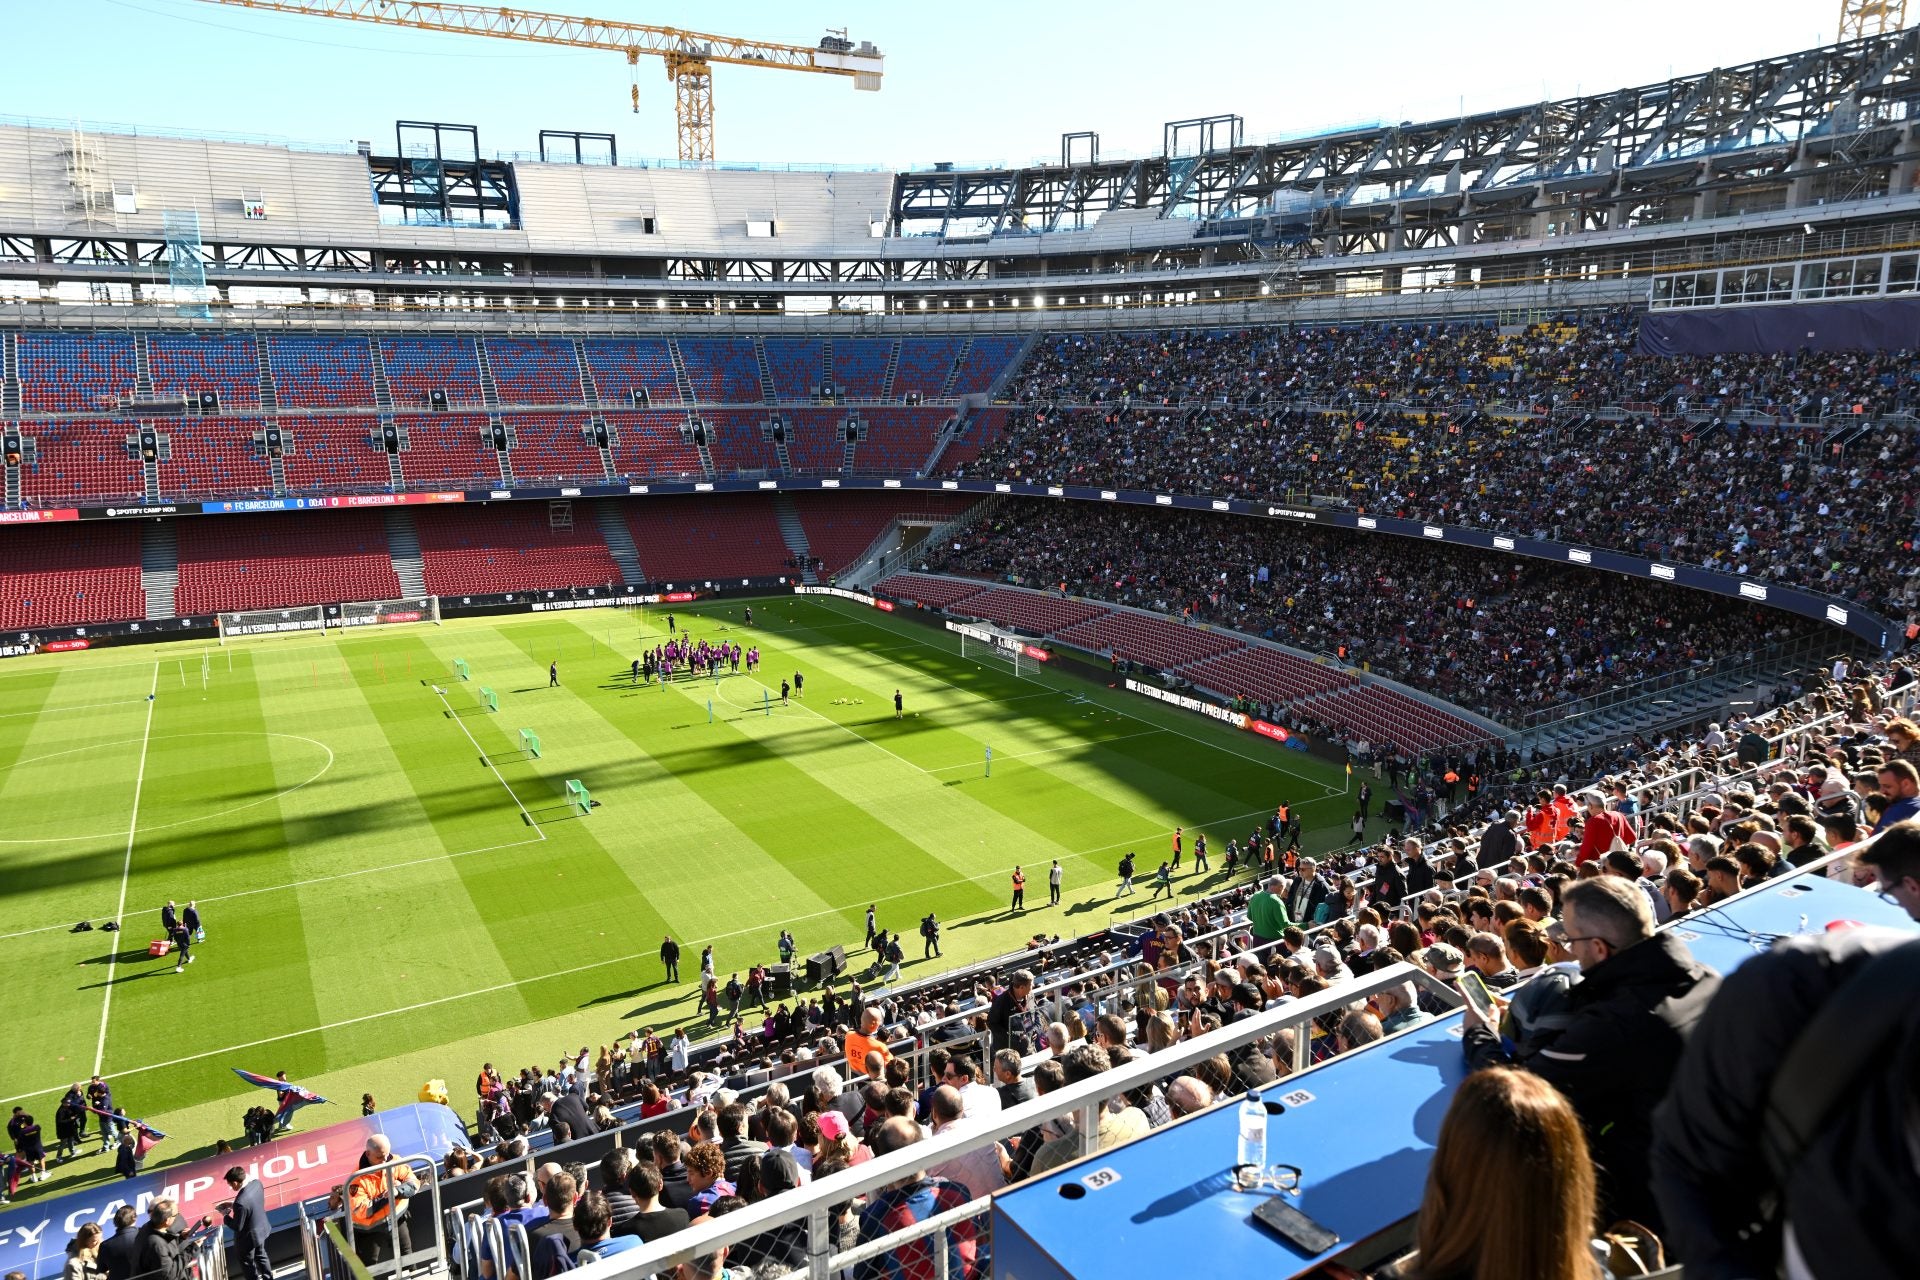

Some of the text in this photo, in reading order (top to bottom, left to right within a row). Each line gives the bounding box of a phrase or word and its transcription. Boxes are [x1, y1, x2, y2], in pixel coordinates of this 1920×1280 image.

[235, 503, 244, 511] FC
[245, 500, 285, 510] BARCELONA
[296, 499, 304, 508] 0
[331, 497, 339, 506] 0
[348, 495, 396, 505] FC BARCELONA
[1292, 510, 1306, 518] CAMP
[3, 646, 15, 656] DE
[1285, 1092, 1310, 1105] 38
[1088, 1171, 1113, 1187] 39
